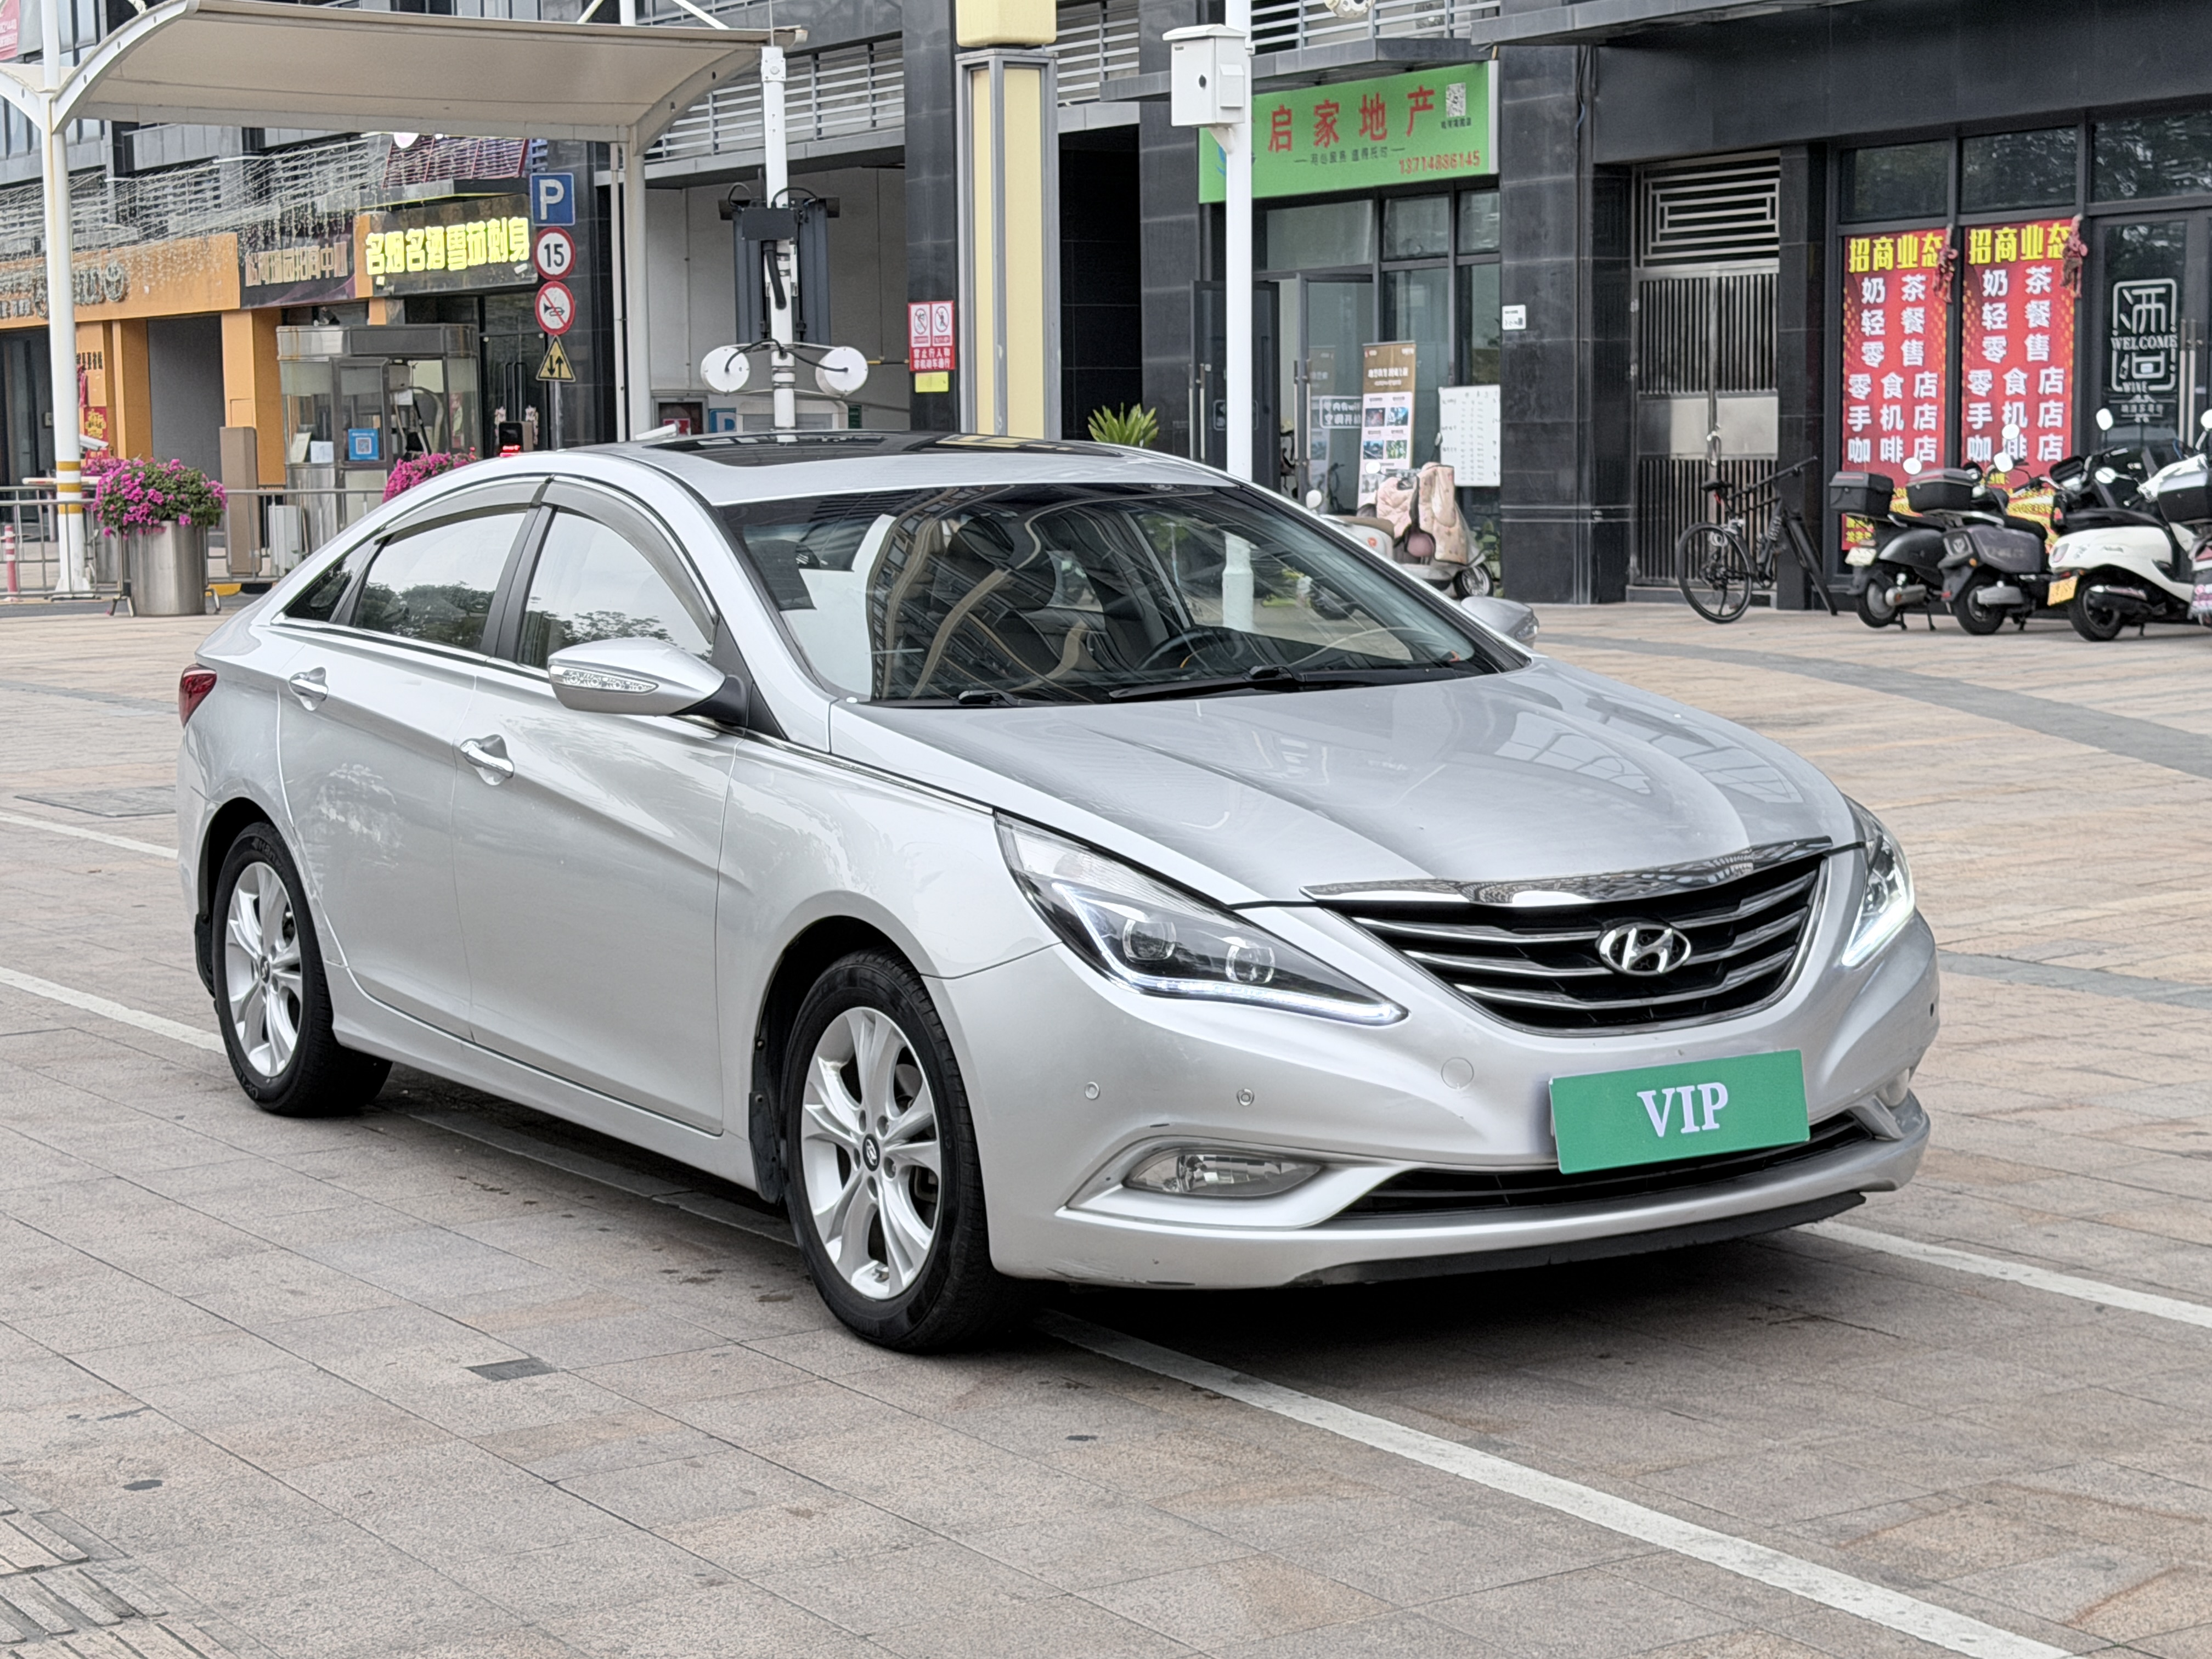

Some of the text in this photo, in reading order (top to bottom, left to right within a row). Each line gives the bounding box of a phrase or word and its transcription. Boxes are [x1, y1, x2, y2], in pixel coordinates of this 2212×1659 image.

[1267, 84, 1436, 153] 启家地产
[540, 179, 564, 220] P
[366, 217, 530, 275] 名烟名酒雪茄刺身
[544, 244, 564, 267] 15
[1849, 232, 1943, 273] 招商业态
[1968, 223, 2070, 265] 招商业态
[1861, 273, 1927, 304] 奶茶
[1982, 264, 2053, 297] 奶茶
[1861, 307, 1925, 336] 轻餐
[1982, 300, 2051, 331] 轻餐
[1861, 338, 1924, 368] 零售
[1982, 333, 2050, 363] 零售
[2111, 334, 2178, 351] WELCOME
[1848, 371, 1938, 400] 零食店
[1967, 366, 2064, 397] 零食店
[2121, 381, 2148, 394] WINE
[1847, 403, 1938, 432] 手机店
[1966, 400, 2064, 430] 手机店
[1848, 435, 1937, 464] 咖啡店
[1967, 433, 2063, 462] 咖啡店
[1637, 1082, 1729, 1137] VIP
